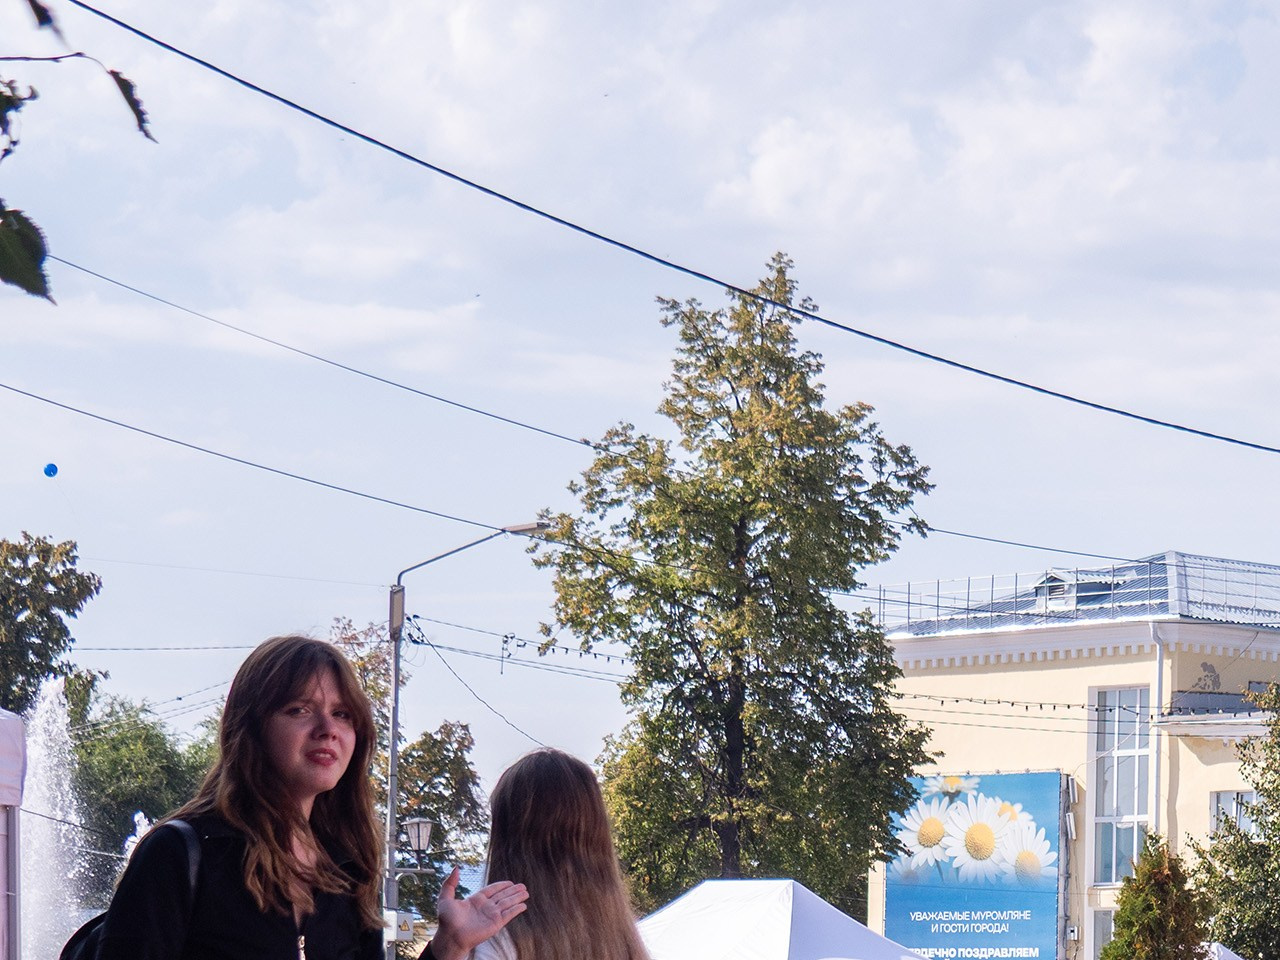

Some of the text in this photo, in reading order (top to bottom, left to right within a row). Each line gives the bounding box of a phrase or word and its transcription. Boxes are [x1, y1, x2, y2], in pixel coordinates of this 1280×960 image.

[910, 910, 1031, 921] УВАЖАЕМЫЕ МУРОМЛЯНЕ
[931, 923, 1009, 934] И ГОСТИ ГОРОДА!
[957, 948, 1039, 959] ПОЗДРАВЛЯЕМ
